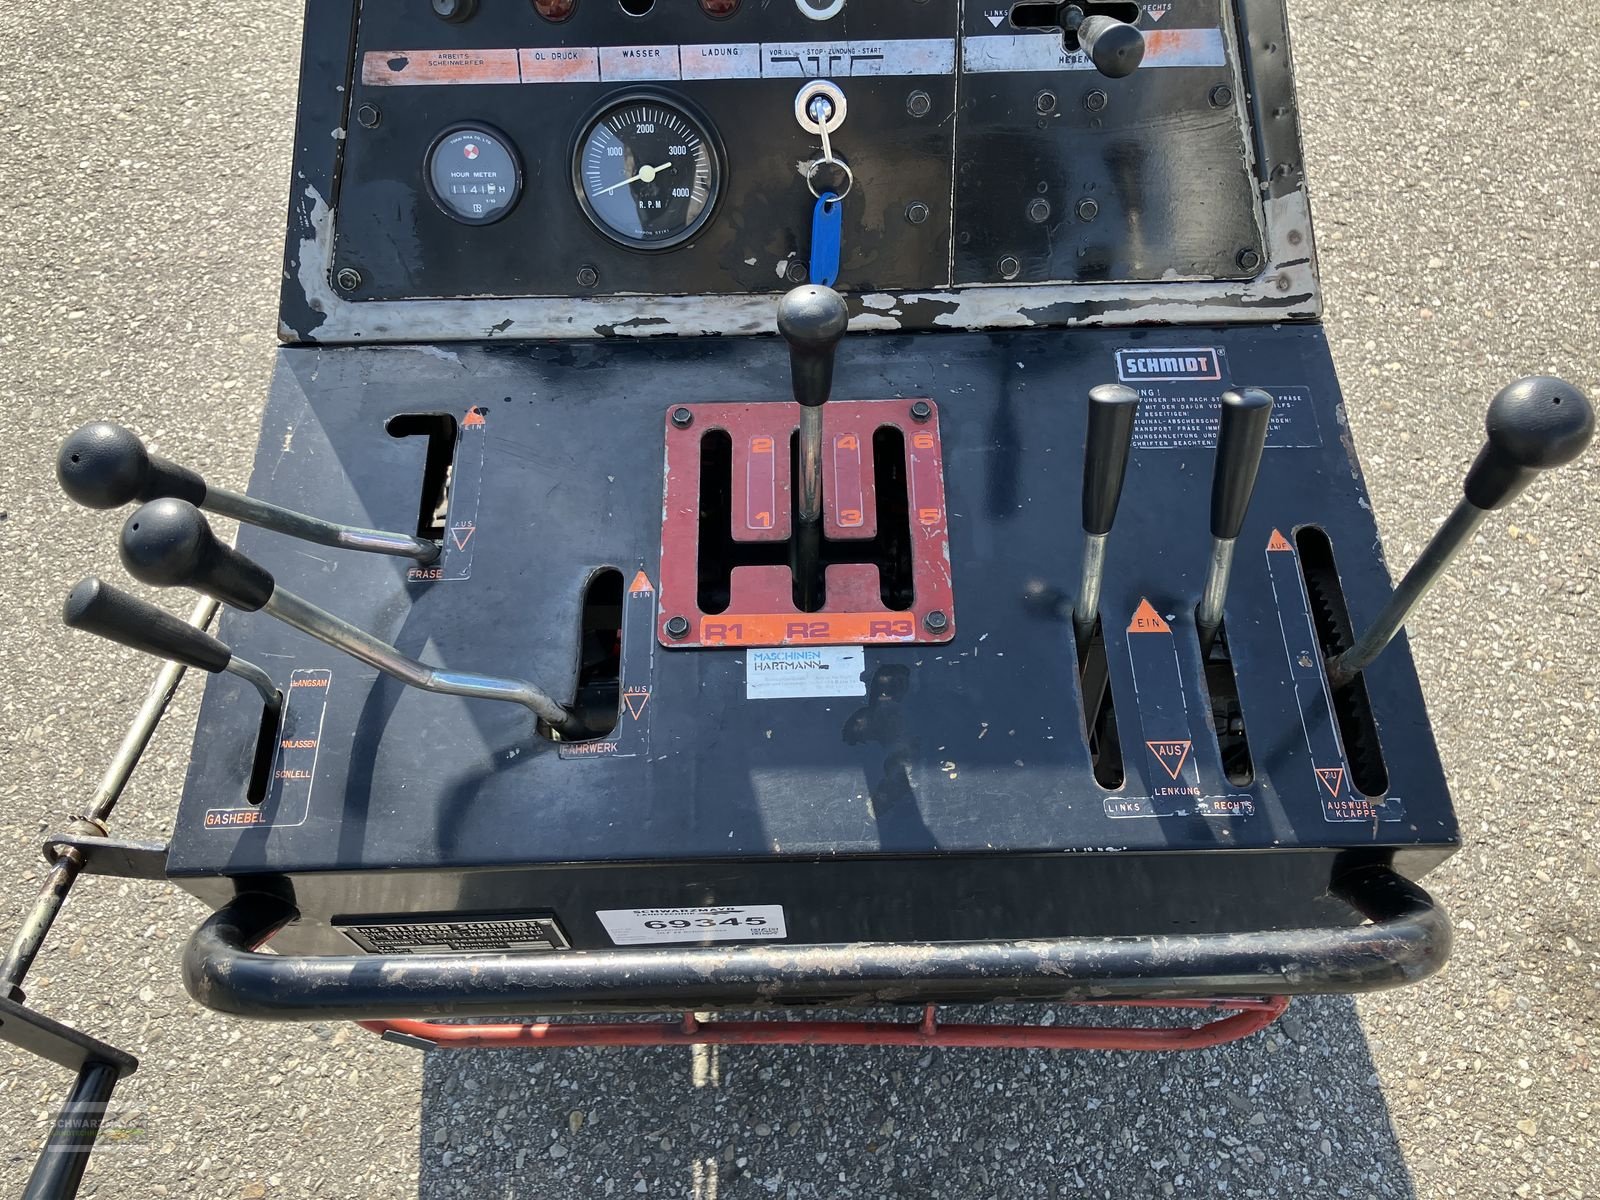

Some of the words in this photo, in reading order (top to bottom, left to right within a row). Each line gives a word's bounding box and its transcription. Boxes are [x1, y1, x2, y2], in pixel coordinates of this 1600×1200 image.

[1142, 3, 1172, 11] RECHTS
[551, 52, 579, 61] DRUCK
[622, 49, 660, 58] WASSER
[701, 48, 739, 57] LADUNG
[1058, 55, 1089, 65] HEBEN
[636, 124, 655, 134] 2000
[606, 146, 623, 157] 1000
[668, 145, 687, 156] 3000
[608, 188, 614, 196] 0
[671, 187, 690, 198] 4000
[1125, 356, 1208, 373] SCHMIDT
[751, 437, 773, 454] 2
[836, 436, 858, 451] 4
[913, 434, 934, 450] 6
[754, 511, 770, 527] 1
[840, 509, 861, 525] 3
[919, 508, 939, 524] 5
[632, 591, 650, 599] EIN
[1136, 618, 1160, 628] EIN
[704, 623, 743, 641] R1
[786, 621, 830, 639] R2
[869, 619, 914, 638] R3
[753, 650, 821, 661] MASCHINEN
[754, 660, 821, 671] HARTMANN
[628, 685, 648, 693] AUS
[281, 740, 317, 749] ANLASSEN
[1158, 745, 1183, 756] AUS
[1154, 787, 1201, 796] LENKUNG
[1108, 803, 1141, 812] LINKS
[1213, 801, 1253, 810] RECHTS
[206, 812, 267, 825] GASHEBEL
[1335, 809, 1377, 818] KLAPPE
[457, 921, 537, 930] SCHMIDT
[644, 916, 767, 930] 69345
